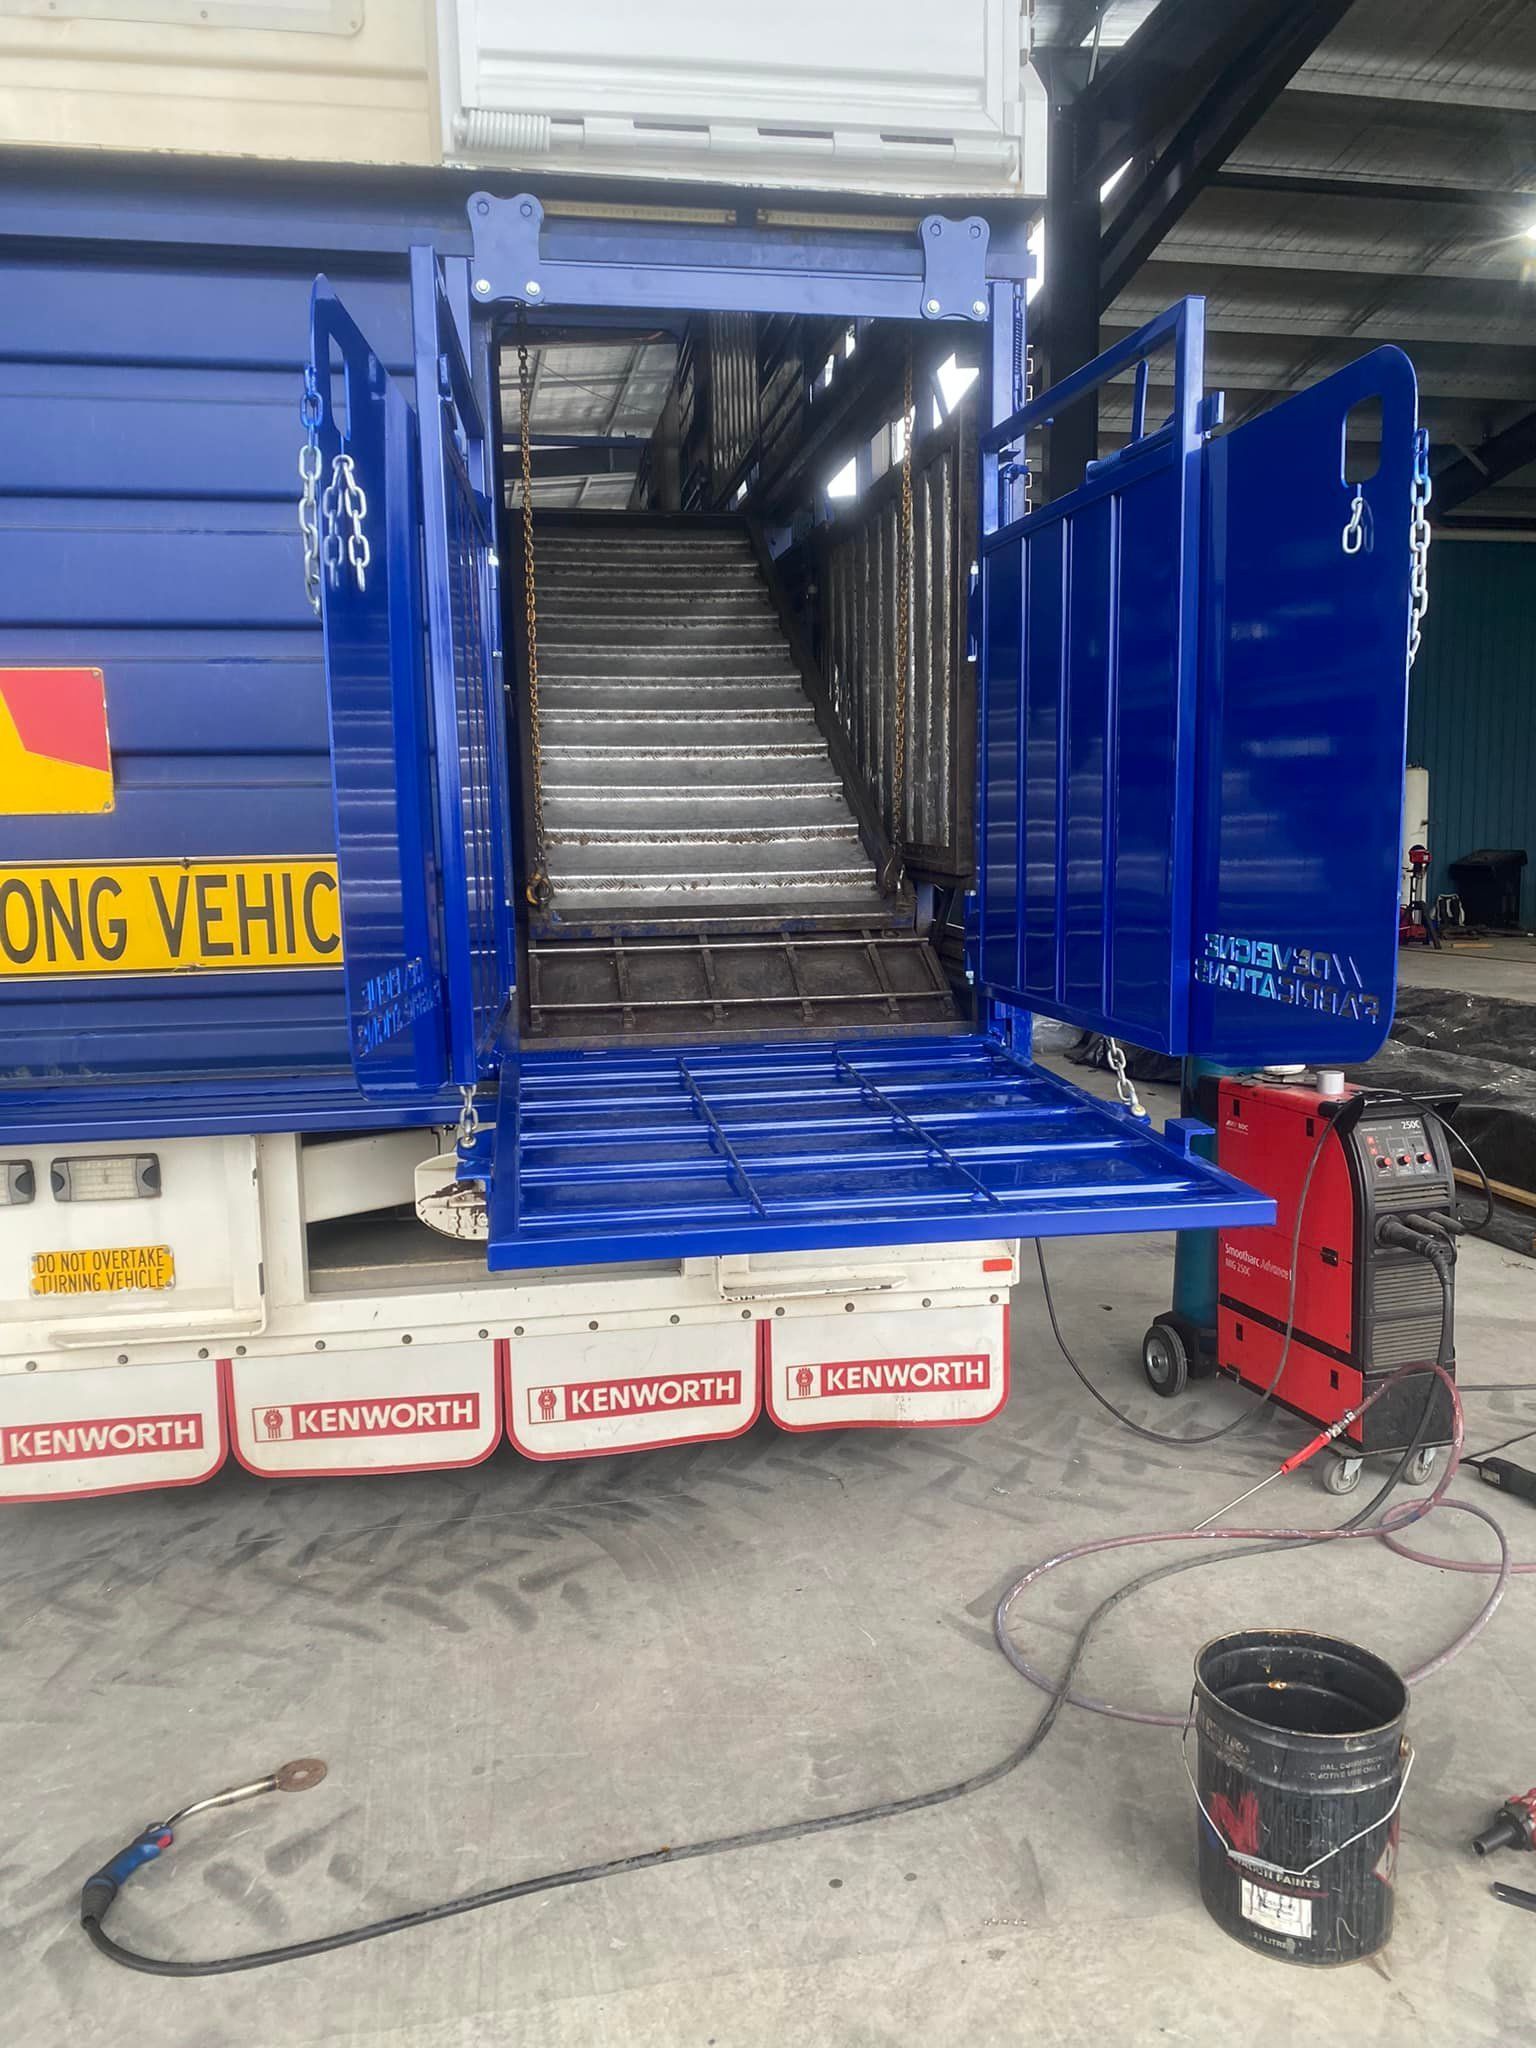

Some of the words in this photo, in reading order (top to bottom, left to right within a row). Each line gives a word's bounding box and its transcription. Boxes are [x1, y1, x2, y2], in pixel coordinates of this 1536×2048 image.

[1401, 1119, 1421, 1130] 250C
[37, 1253, 56, 1273] DO
[60, 1252, 88, 1273] NOT
[92, 1247, 165, 1271] OVERTAKE
[1225, 1243, 1260, 1267] Smootharc
[40, 1271, 101, 1294] TURNING
[105, 1268, 165, 1291] VEHICLE
[826, 1360, 985, 1392] KENWORTH
[570, 1377, 737, 1415] KENWORTH
[298, 1399, 473, 1434] KENWORTH
[9, 1419, 197, 1459] KENWORTH
